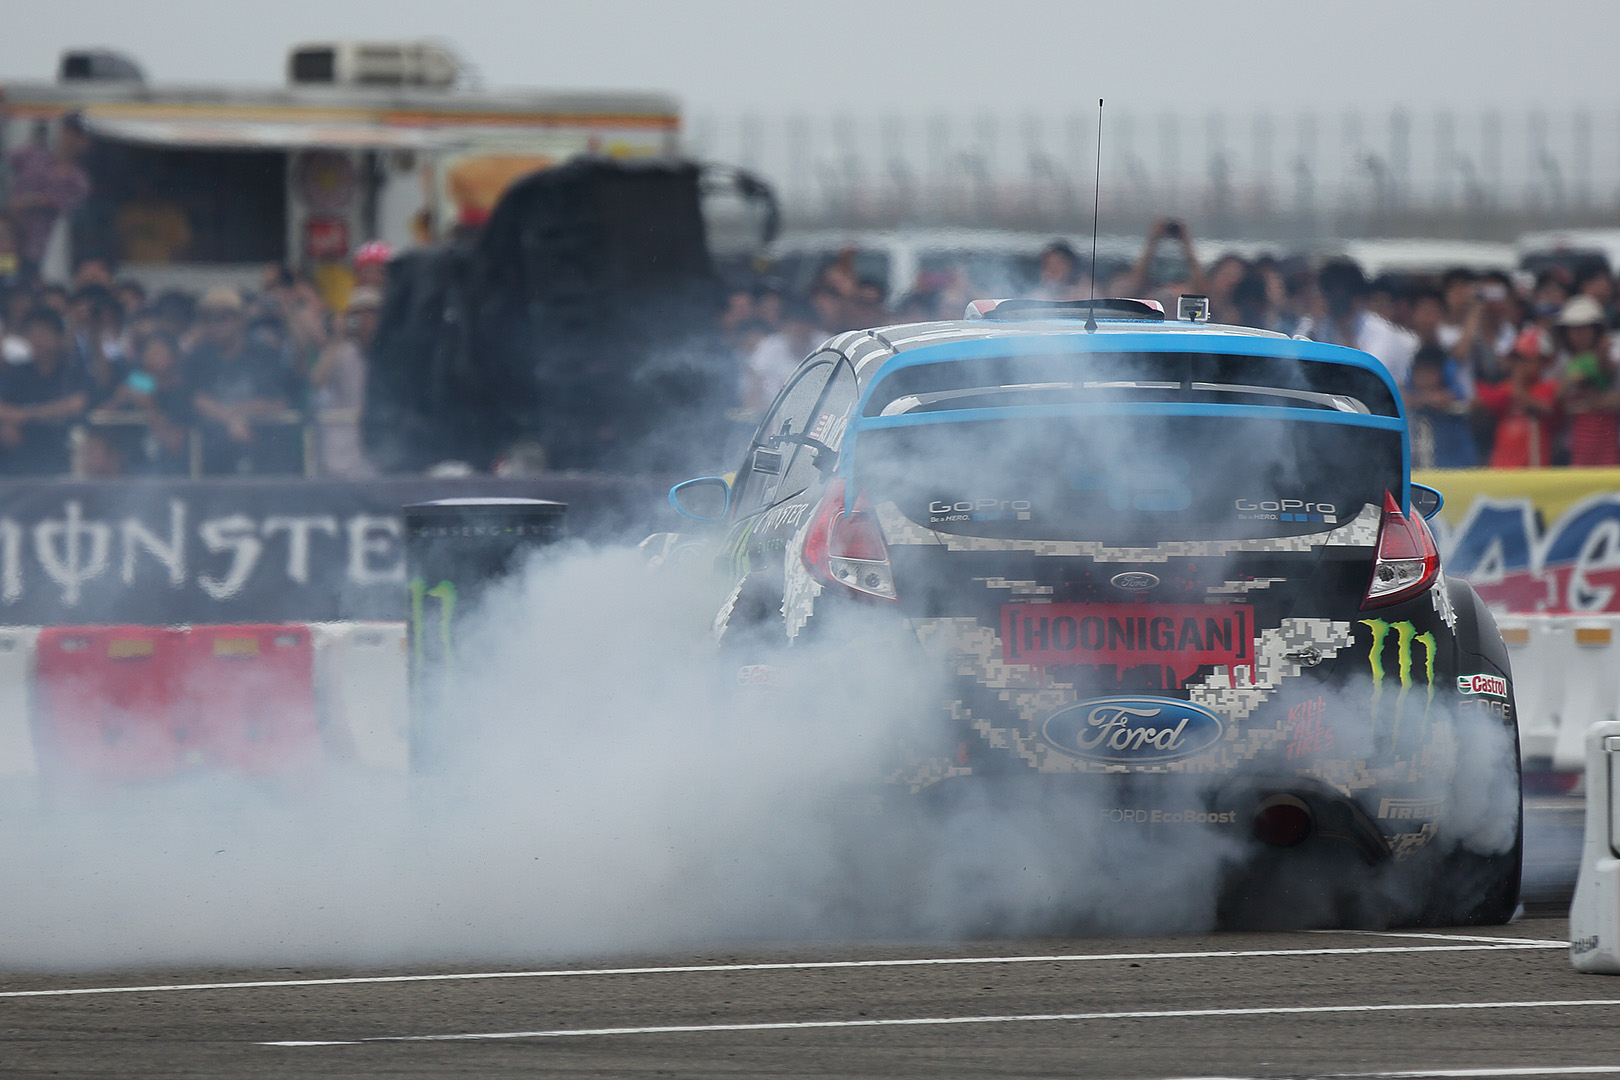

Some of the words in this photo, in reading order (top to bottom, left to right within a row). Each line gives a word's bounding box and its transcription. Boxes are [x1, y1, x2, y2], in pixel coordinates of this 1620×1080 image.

[929, 498, 1031, 514] GoPro
[1235, 498, 1336, 514] GoPro
[1120, 574, 1150, 587] Ford
[1472, 675, 1507, 696] Castrol
[1287, 695, 1327, 725] KILL
[1458, 699, 1512, 720] EDGE
[1076, 705, 1189, 751] Ford
[1101, 808, 1147, 823] FORD
[1150, 809, 1237, 824] EcoBoost
